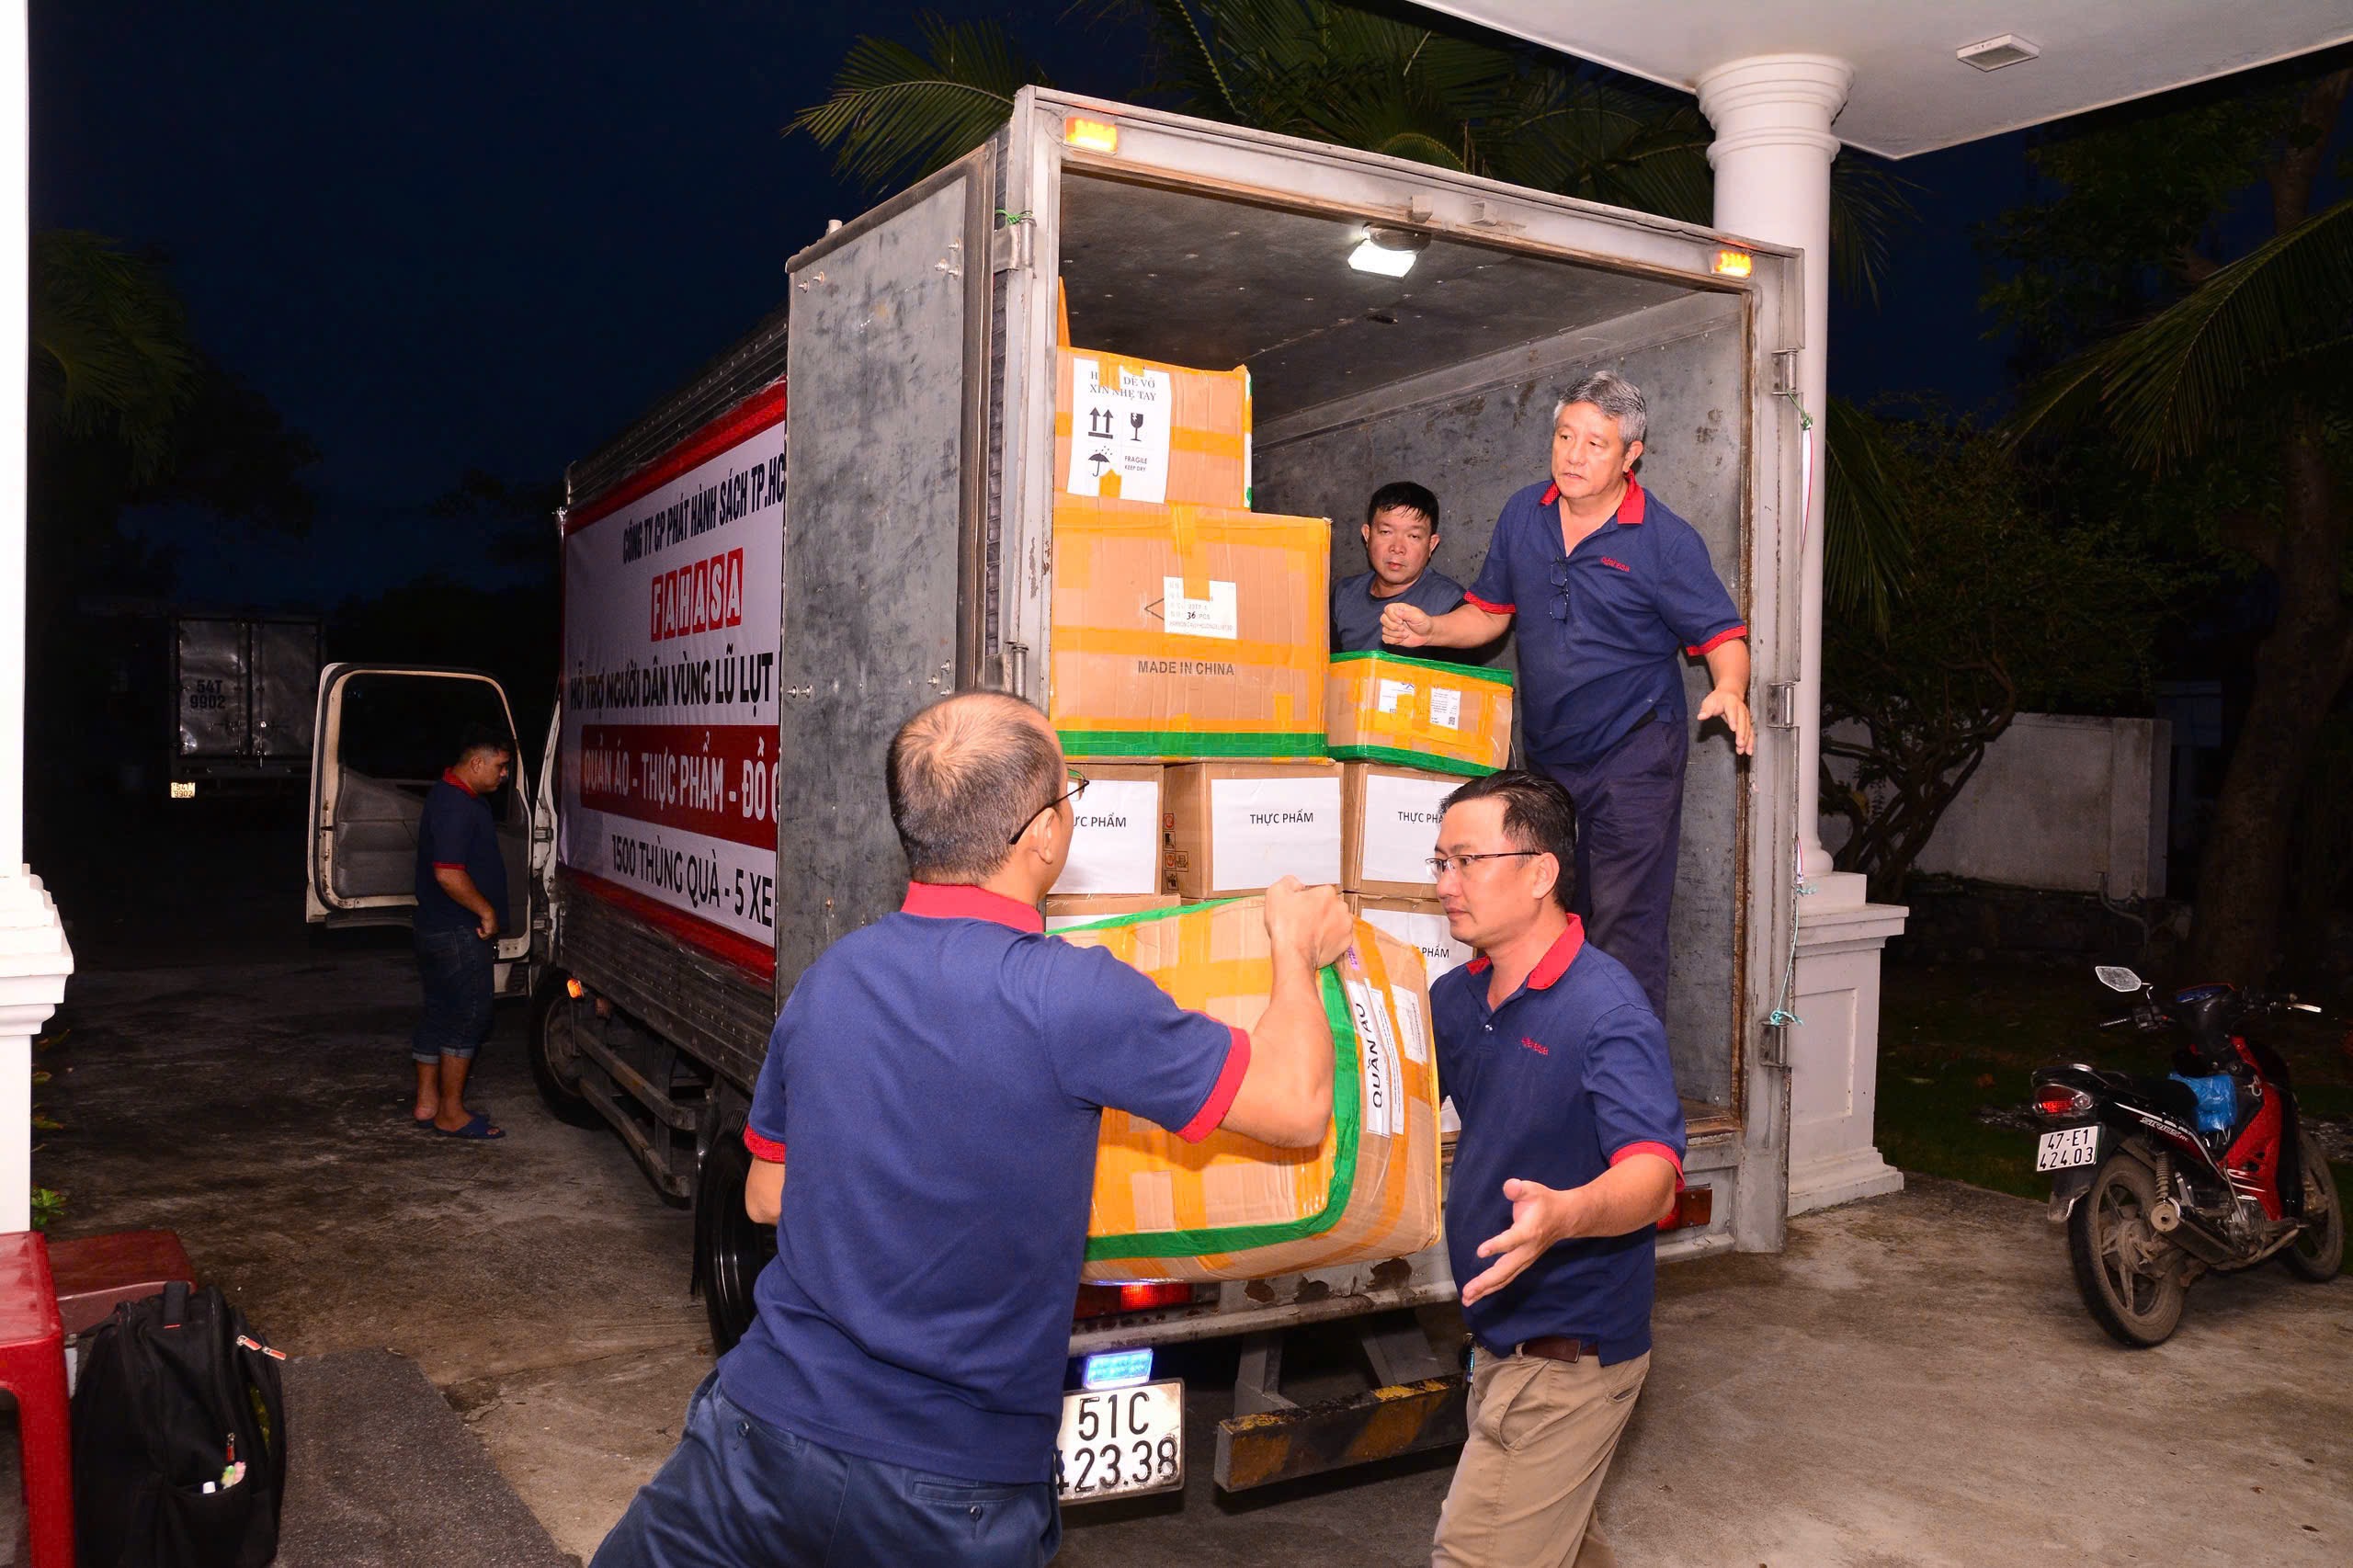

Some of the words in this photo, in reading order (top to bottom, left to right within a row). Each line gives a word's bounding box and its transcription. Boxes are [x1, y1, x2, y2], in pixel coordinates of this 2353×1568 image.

[1089, 383, 1109, 394] XIN
[1137, 390, 1156, 402] TAY
[1124, 455, 1148, 464] FRAGILE
[623, 518, 642, 564] CÔNG
[643, 517, 654, 557] TY
[654, 511, 665, 552] CP
[666, 493, 689, 547] PHÁT
[690, 483, 718, 538] HÀNH
[719, 468, 748, 526] SÁCH
[651, 549, 743, 641] FAHASA
[1186, 610, 1197, 620] 36
[1138, 660, 1176, 674] MADE
[1180, 661, 1192, 674] IN
[1196, 662, 1234, 676] CHINA
[197, 679, 222, 694] 54T
[571, 661, 584, 710] HỖ
[586, 667, 605, 720] TRỢ
[607, 659, 641, 709] NGƯỜI
[642, 655, 668, 707] DÂN
[672, 651, 711, 706] VÙNG
[715, 642, 734, 704] LŨ
[740, 652, 773, 717] LỤT
[189, 694, 226, 710] 9902
[614, 737, 630, 796] ÁO
[642, 745, 676, 811] THỰC
[680, 731, 723, 813] PHẨM
[1091, 812, 1127, 827] PHẨM
[1249, 812, 1280, 826] THỰC
[1282, 809, 1313, 824] PHẨM
[1398, 812, 1424, 824] THỰC
[612, 834, 636, 878] 1500
[639, 835, 683, 893] THÙNG
[688, 848, 720, 909] QUÀ
[735, 868, 745, 916] 5
[748, 872, 773, 928] XE
[1422, 943, 1449, 959] PHẨM
[1367, 1039, 1383, 1108] QUẦN
[2047, 1130, 2089, 1150] 47-E1
[2039, 1146, 2094, 1170] 424.03
[1078, 1391, 1150, 1442] 51C
